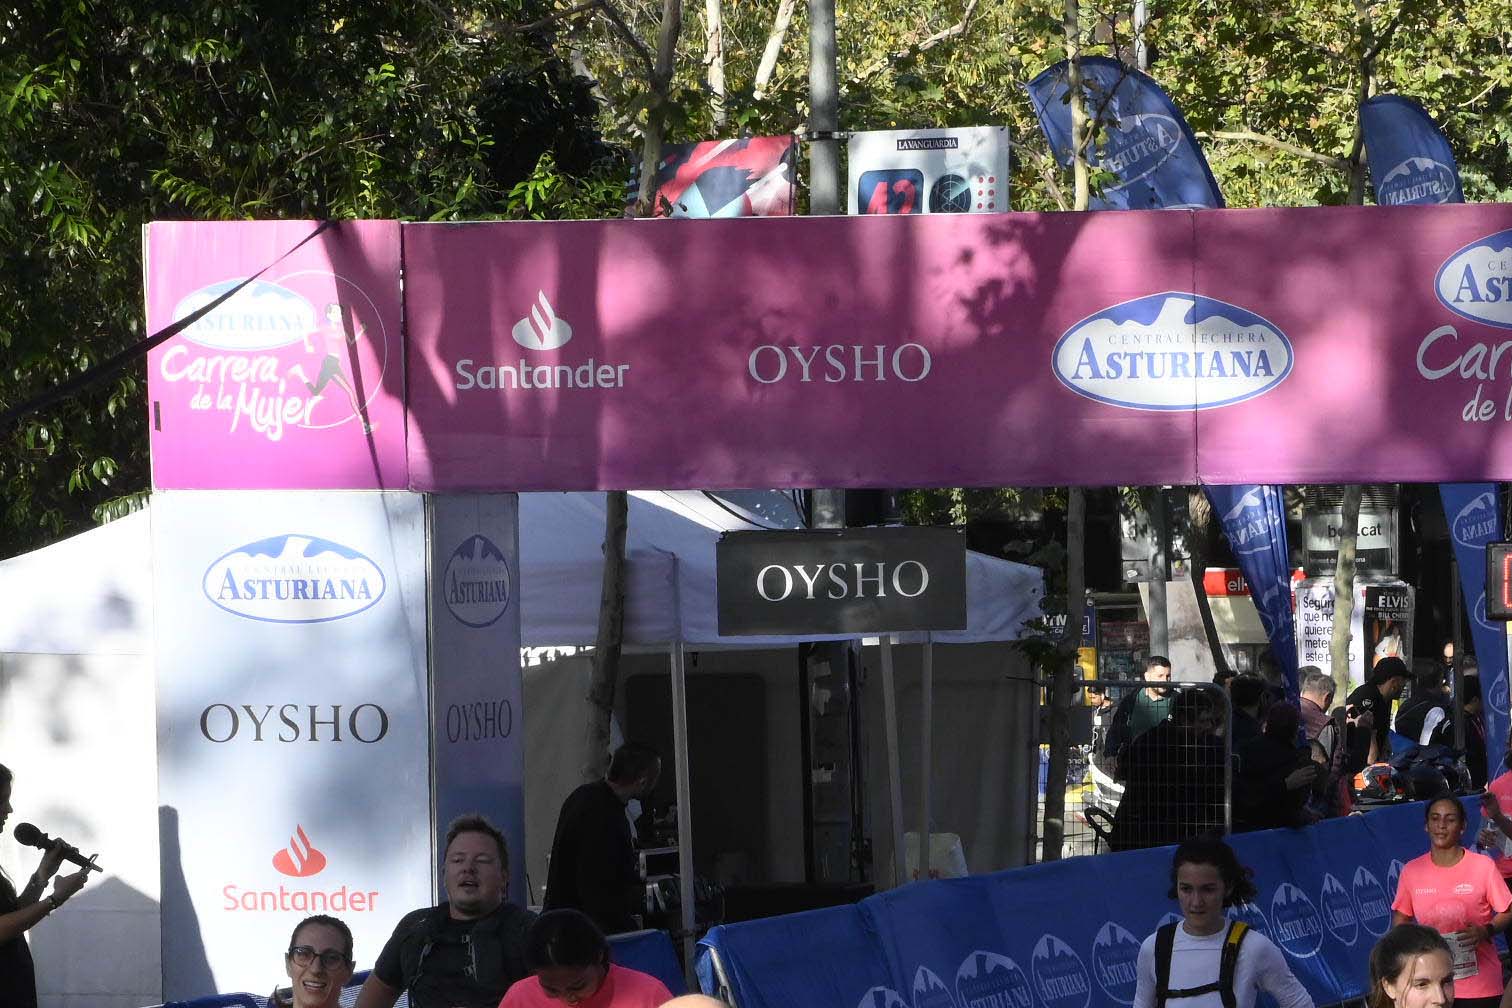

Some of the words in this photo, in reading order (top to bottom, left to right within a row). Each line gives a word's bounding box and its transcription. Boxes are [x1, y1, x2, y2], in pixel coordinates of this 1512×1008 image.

[1108, 334, 1183, 345] CENTRAL
[1191, 332, 1266, 343] LECHERA
[160, 345, 281, 382] Carrera
[456, 358, 630, 390] Santander
[748, 343, 932, 383] OYSHO
[1071, 337, 1274, 379] ASTURIANA
[190, 383, 212, 410] de
[216, 383, 232, 410] la
[230, 381, 325, 441] Mujer
[1462, 384, 1495, 422] de
[217, 568, 373, 601] ASTURIANA
[449, 570, 506, 605] ASTURIANA
[756, 560, 929, 602] OYSHO
[1378, 596, 1409, 608] ELVIS
[1303, 613, 1319, 626] que
[1304, 625, 1333, 639] quiere
[1304, 638, 1330, 649] mete
[1305, 653, 1323, 662] este
[199, 703, 389, 743] OYSHO
[446, 699, 512, 744] OYSHO
[223, 885, 379, 912] Santander
[1036, 972, 1087, 1002] ASTURIANA
